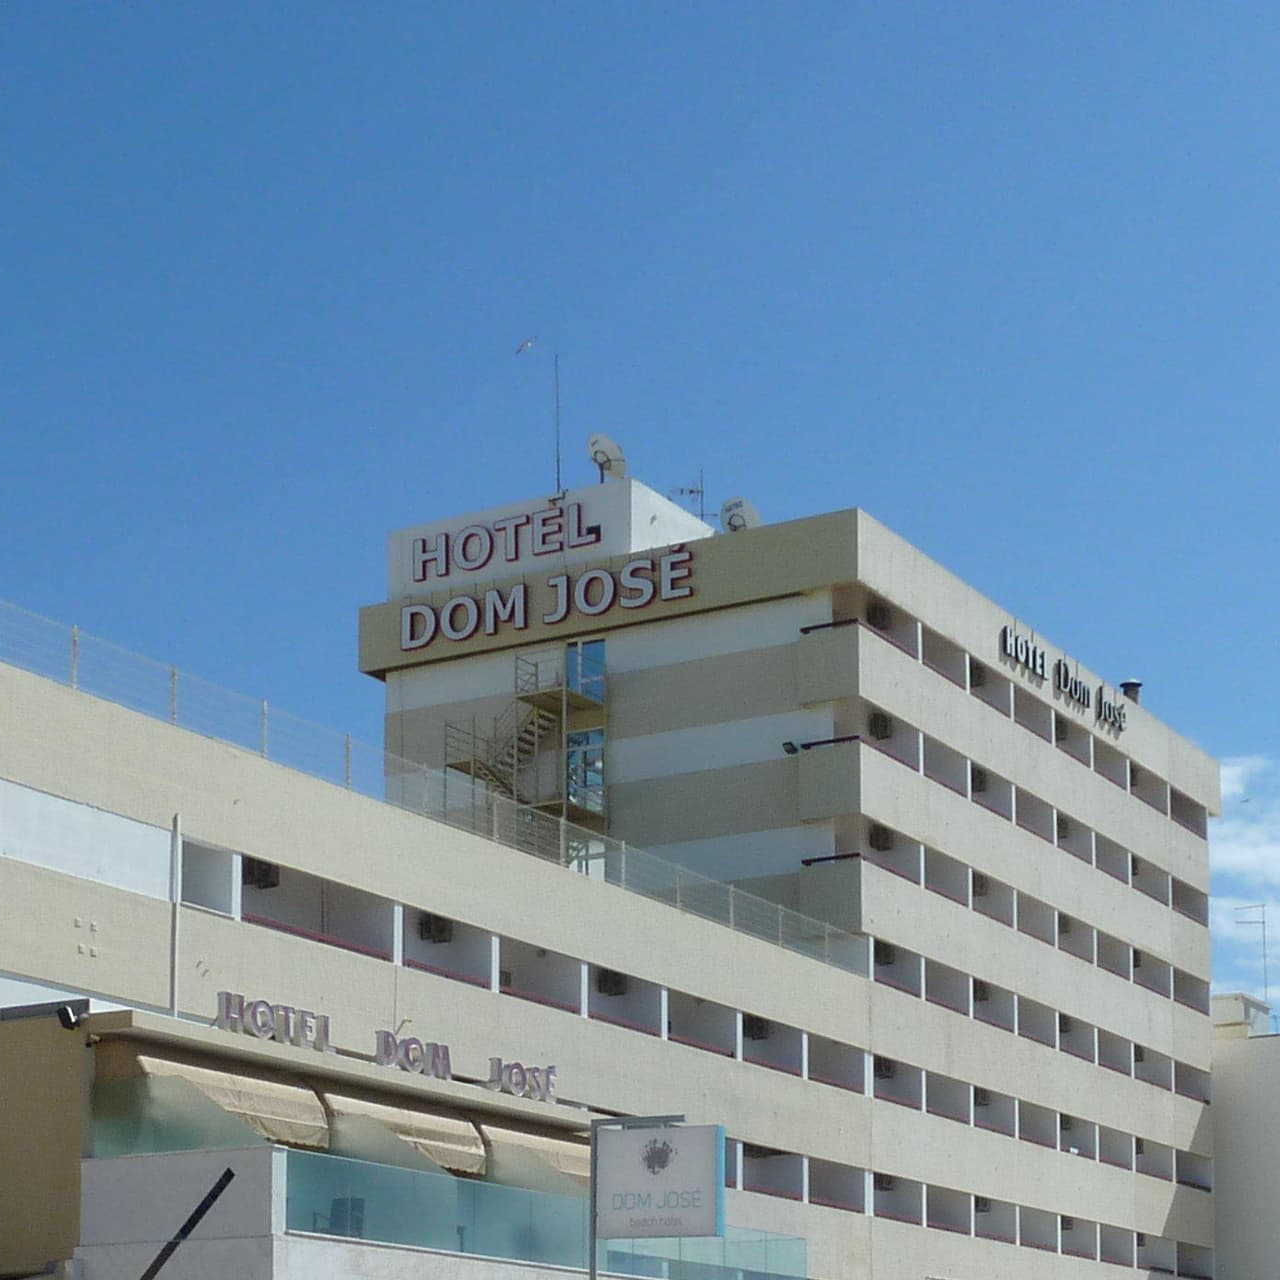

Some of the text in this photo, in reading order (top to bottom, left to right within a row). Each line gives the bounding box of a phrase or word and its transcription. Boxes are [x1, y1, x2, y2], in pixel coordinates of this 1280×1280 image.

[412, 502, 602, 583] HOTEL
[399, 544, 694, 652] DOM JOSÉ
[1002, 624, 1050, 681] HOTEL
[216, 990, 337, 1055] HOTEL
[375, 1029, 453, 1081] DOM
[612, 1186, 704, 1211] DOM JOSÉ
